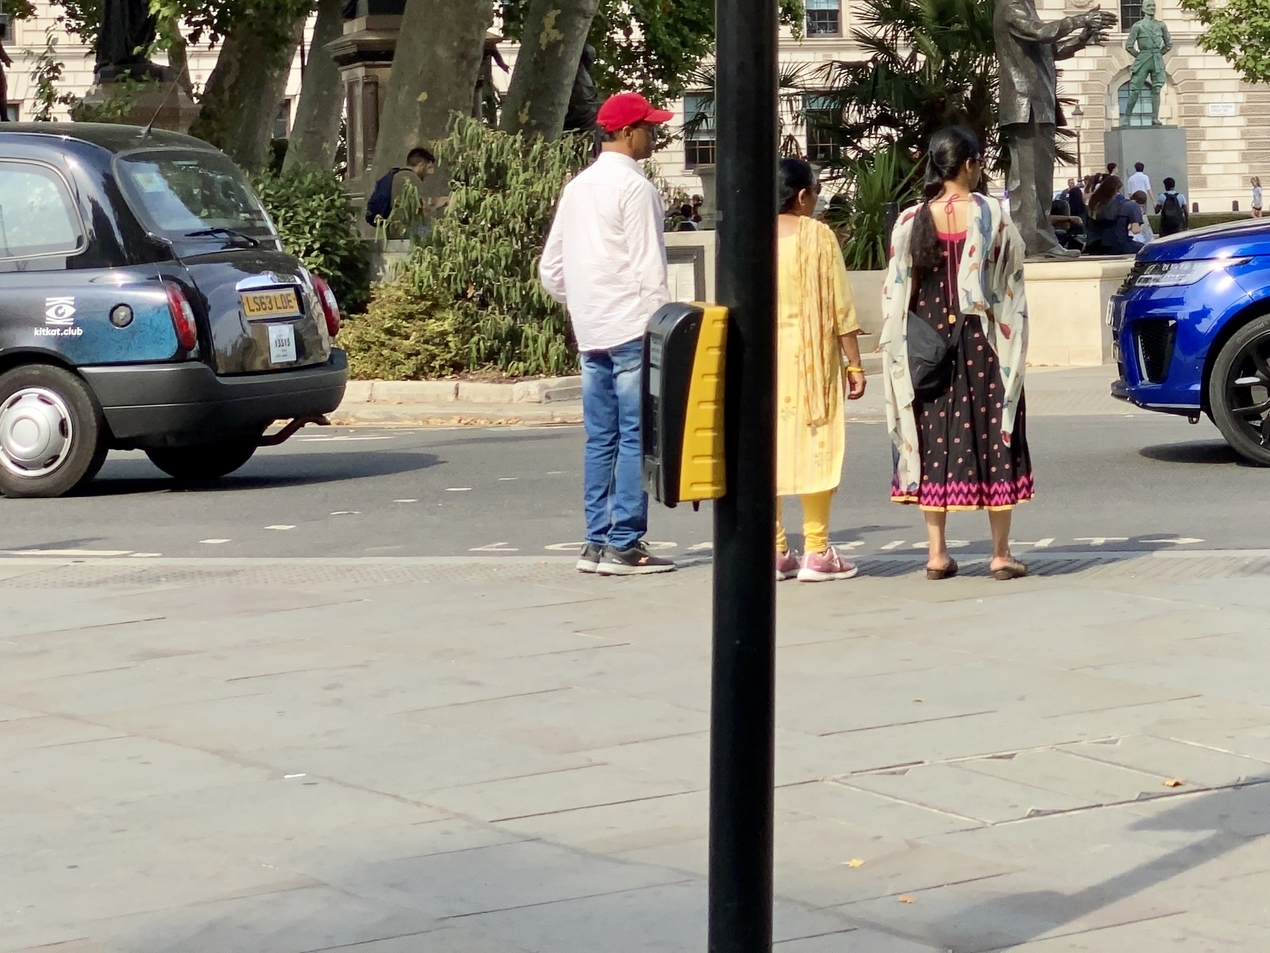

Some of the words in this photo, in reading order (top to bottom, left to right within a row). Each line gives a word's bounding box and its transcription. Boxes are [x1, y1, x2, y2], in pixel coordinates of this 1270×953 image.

[245, 295, 273, 312] LS63
[275, 293, 294, 310] LDE
[34, 327, 83, 336] kitkat.club
